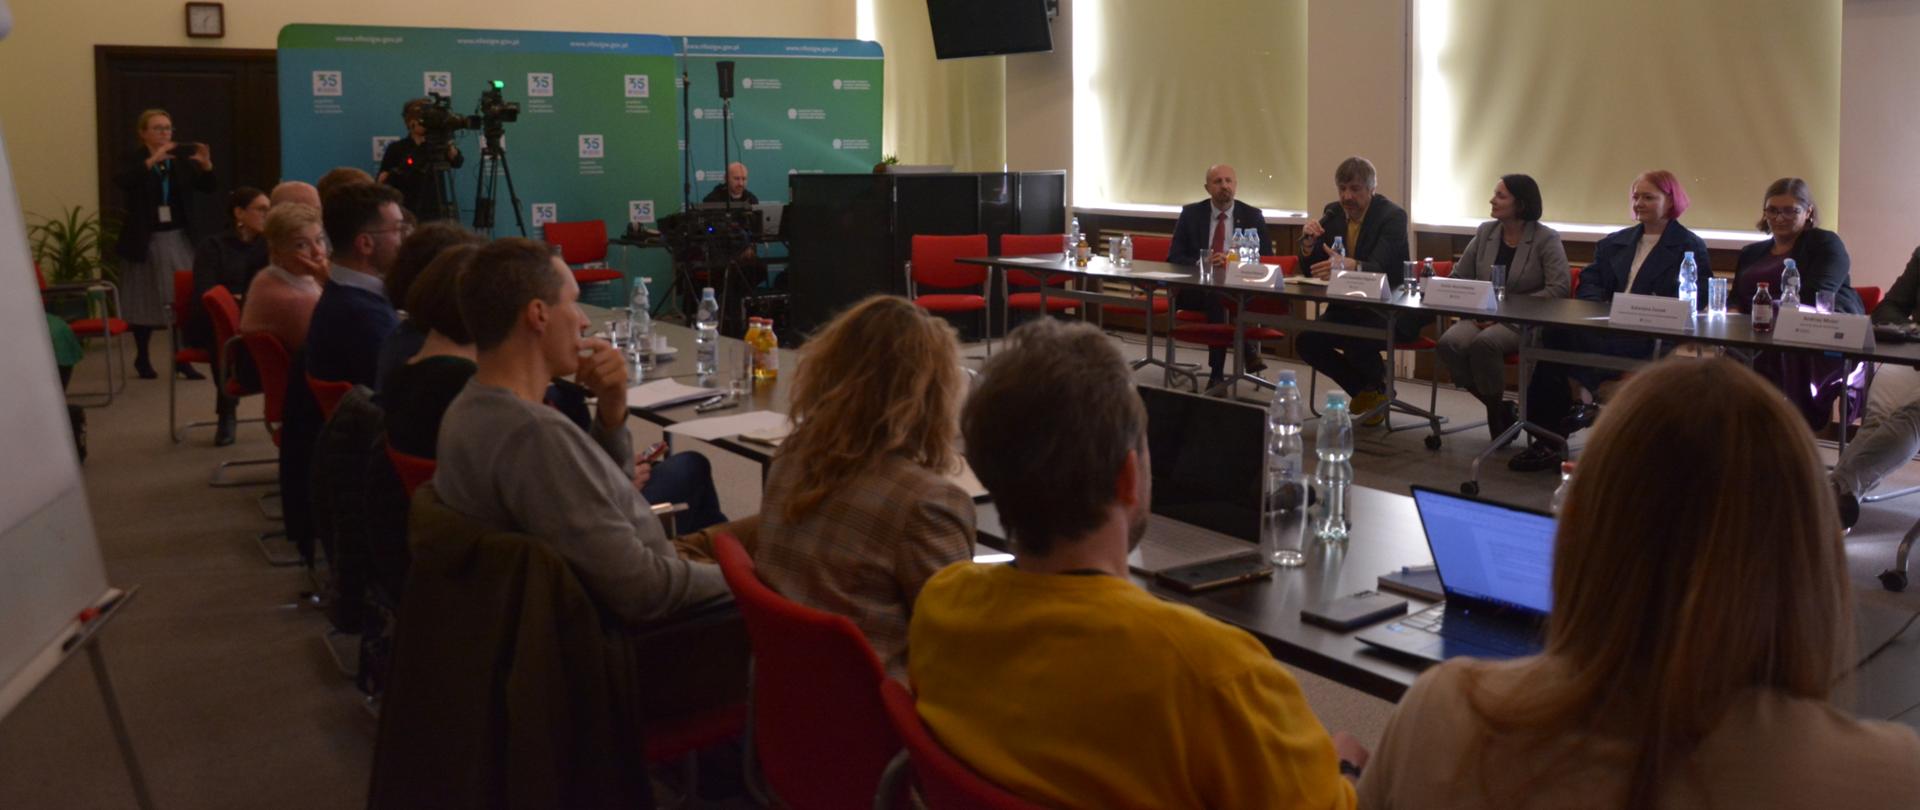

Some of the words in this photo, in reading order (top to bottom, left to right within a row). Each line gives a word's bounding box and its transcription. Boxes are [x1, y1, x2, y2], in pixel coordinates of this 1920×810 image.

[318, 74, 338, 87] 35
[428, 75, 448, 87] 35
[531, 76, 550, 88] 35
[629, 77, 645, 89] 35
[583, 137, 600, 149] 35
[536, 206, 553, 218] 35
[633, 203, 650, 215] 35
